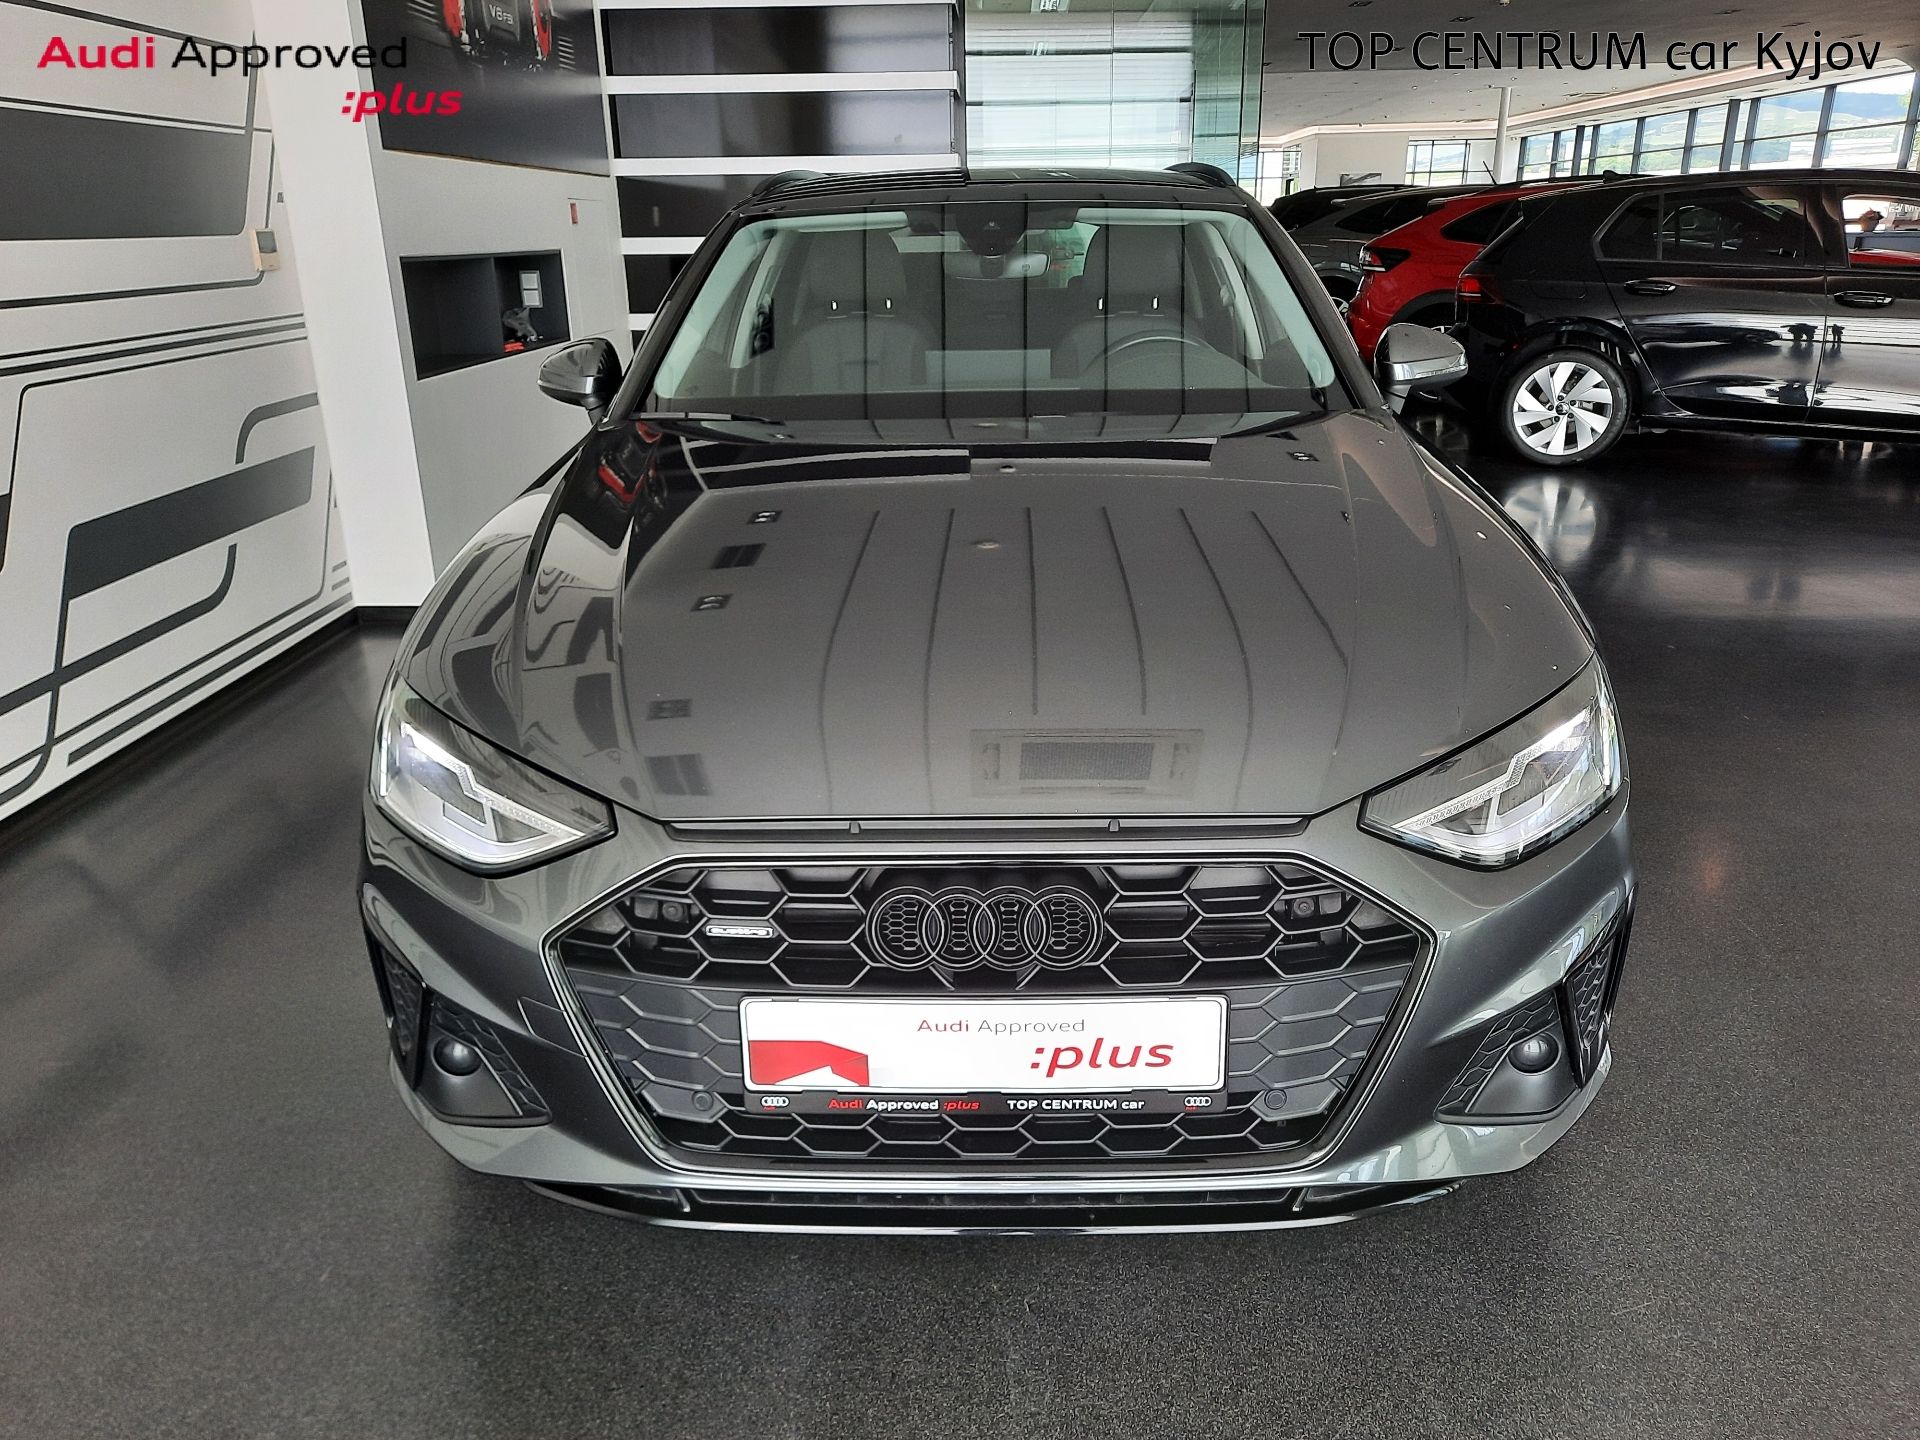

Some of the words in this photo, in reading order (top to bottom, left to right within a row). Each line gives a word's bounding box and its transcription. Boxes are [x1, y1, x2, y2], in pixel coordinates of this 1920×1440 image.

[917, 1019, 969, 1033] Audi
[978, 1019, 1086, 1036] Approved
[1030, 1037, 1175, 1078] :plus
[828, 1099, 863, 1110] Audi
[866, 1099, 939, 1112] Approved
[1007, 1099, 1038, 1110] TOP
[1041, 1099, 1118, 1110] CENTRUM
[1121, 1101, 1145, 1110] car
